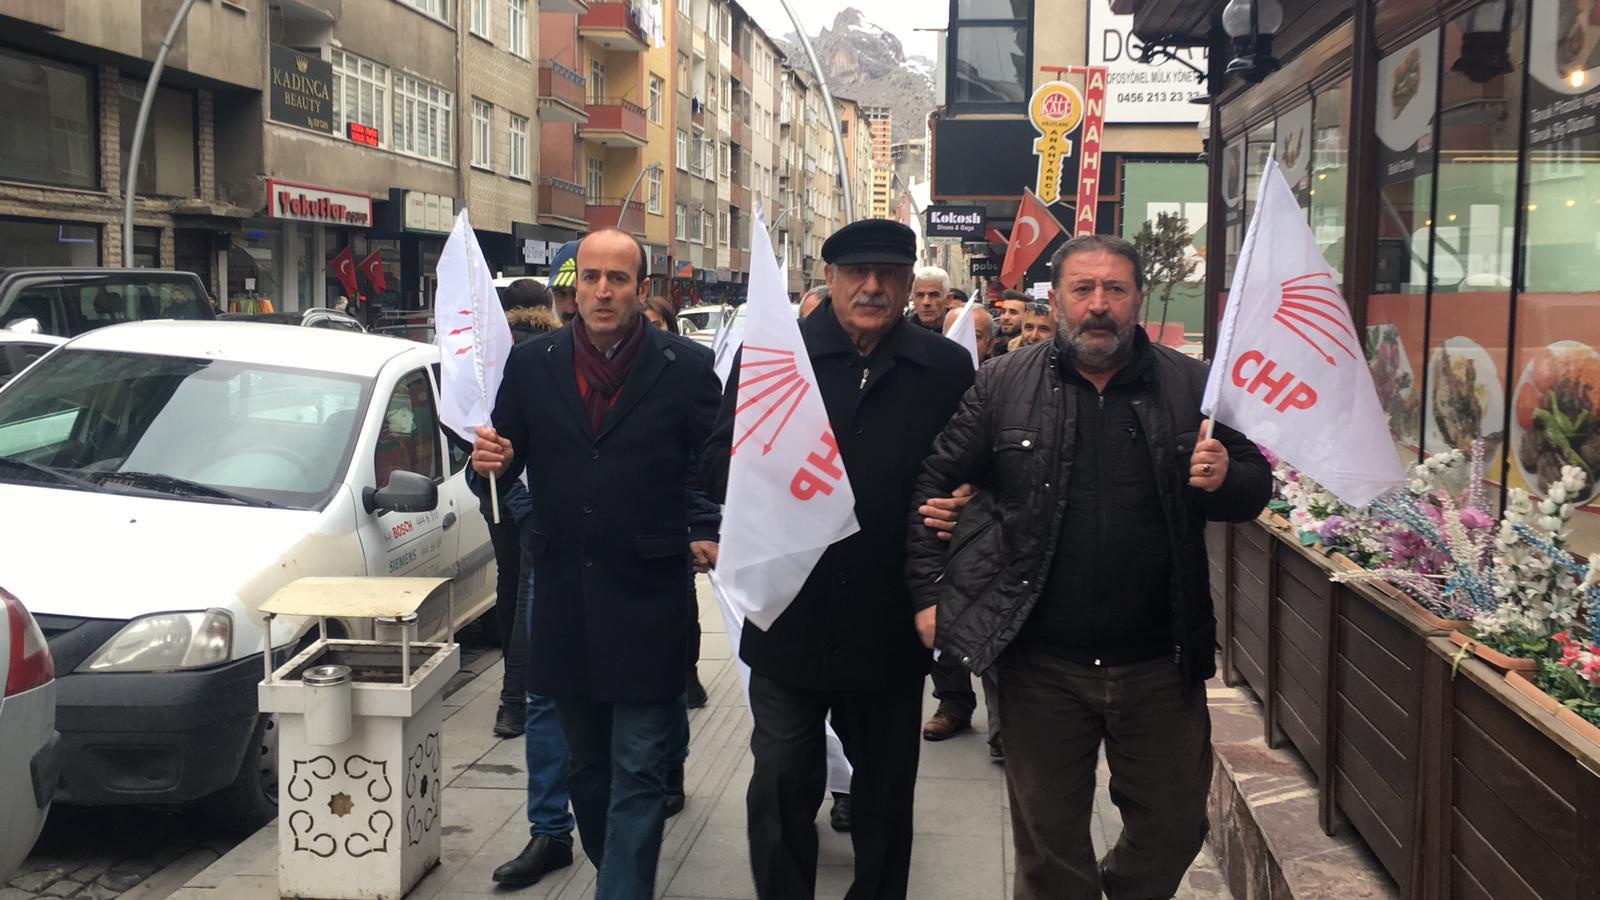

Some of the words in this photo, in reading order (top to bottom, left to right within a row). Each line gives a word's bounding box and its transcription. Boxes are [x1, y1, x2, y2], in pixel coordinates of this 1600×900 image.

[273, 66, 329, 100] KADINCA
[284, 91, 321, 113] BEAUTY
[1040, 98, 1073, 117] KALE
[1117, 92, 1142, 103] 0456
[1147, 92, 1166, 102] 213
[1170, 92, 1184, 102] 23
[1078, 71, 1105, 237] ANAHTA
[279, 191, 346, 223] Yakutlar
[931, 211, 981, 225] Kokosh
[961, 224, 974, 232] Bags
[1231, 349, 1318, 414] CHP
[392, 519, 414, 540] BOSCH
[389, 548, 417, 574] SIEMENS
